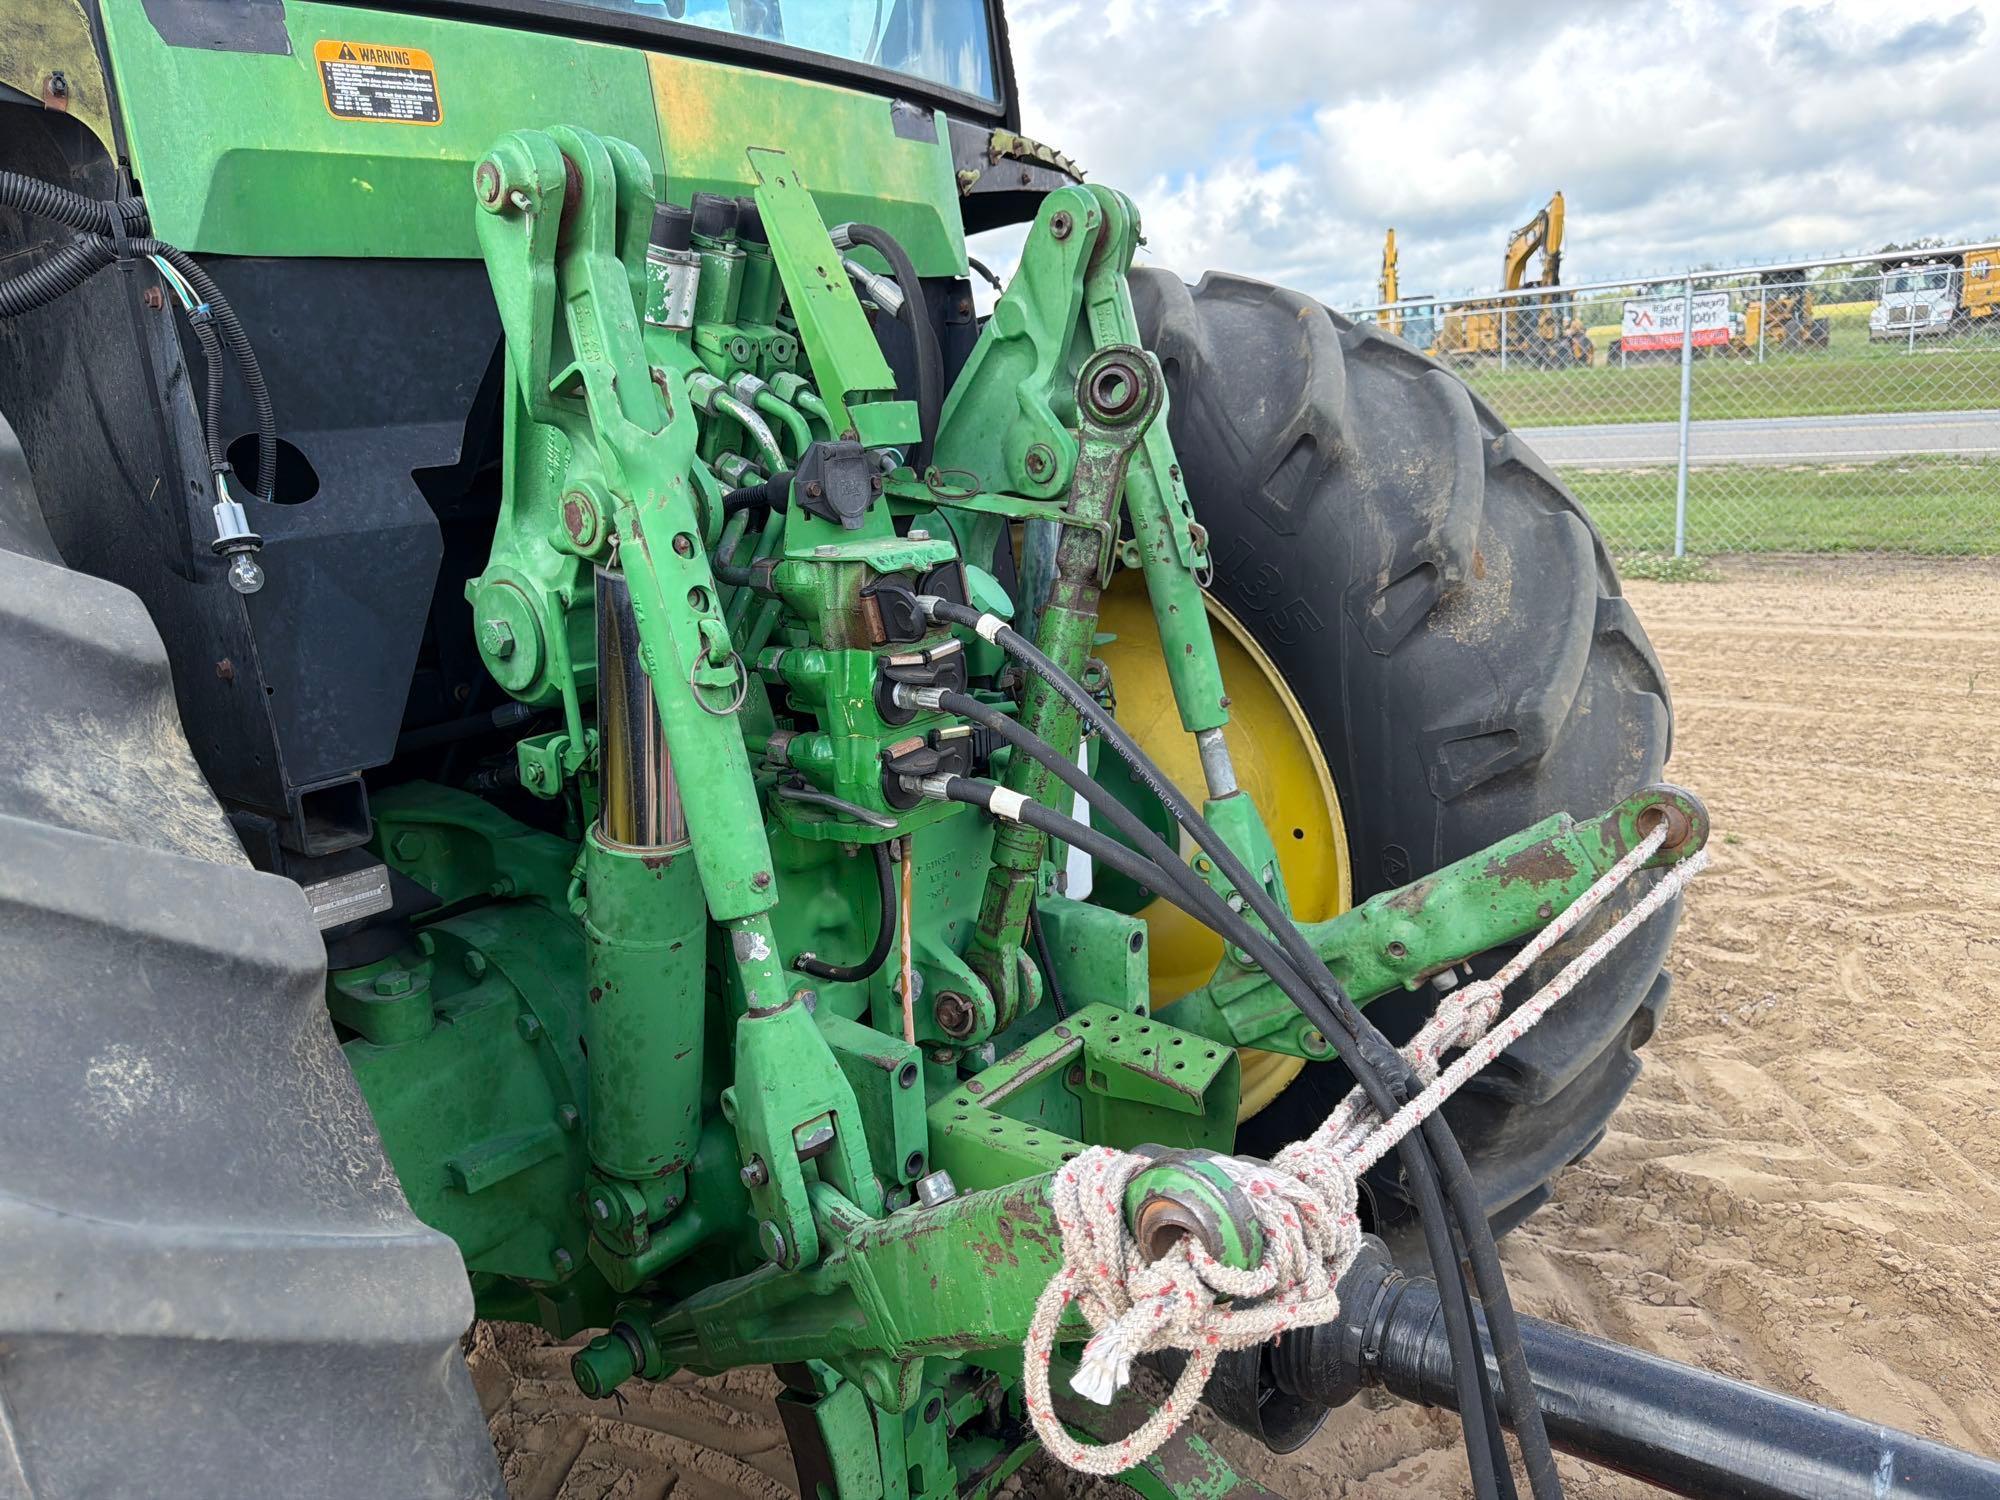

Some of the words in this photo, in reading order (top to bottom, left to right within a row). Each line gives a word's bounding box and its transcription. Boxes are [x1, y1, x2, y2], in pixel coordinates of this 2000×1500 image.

[358, 47, 411, 66] WARNING
[1213, 535, 1326, 645] 135
[1069, 693, 1089, 716] SAE
[1108, 735, 1133, 763] HOSE
[1133, 762, 1184, 821] HYDRAULIC
